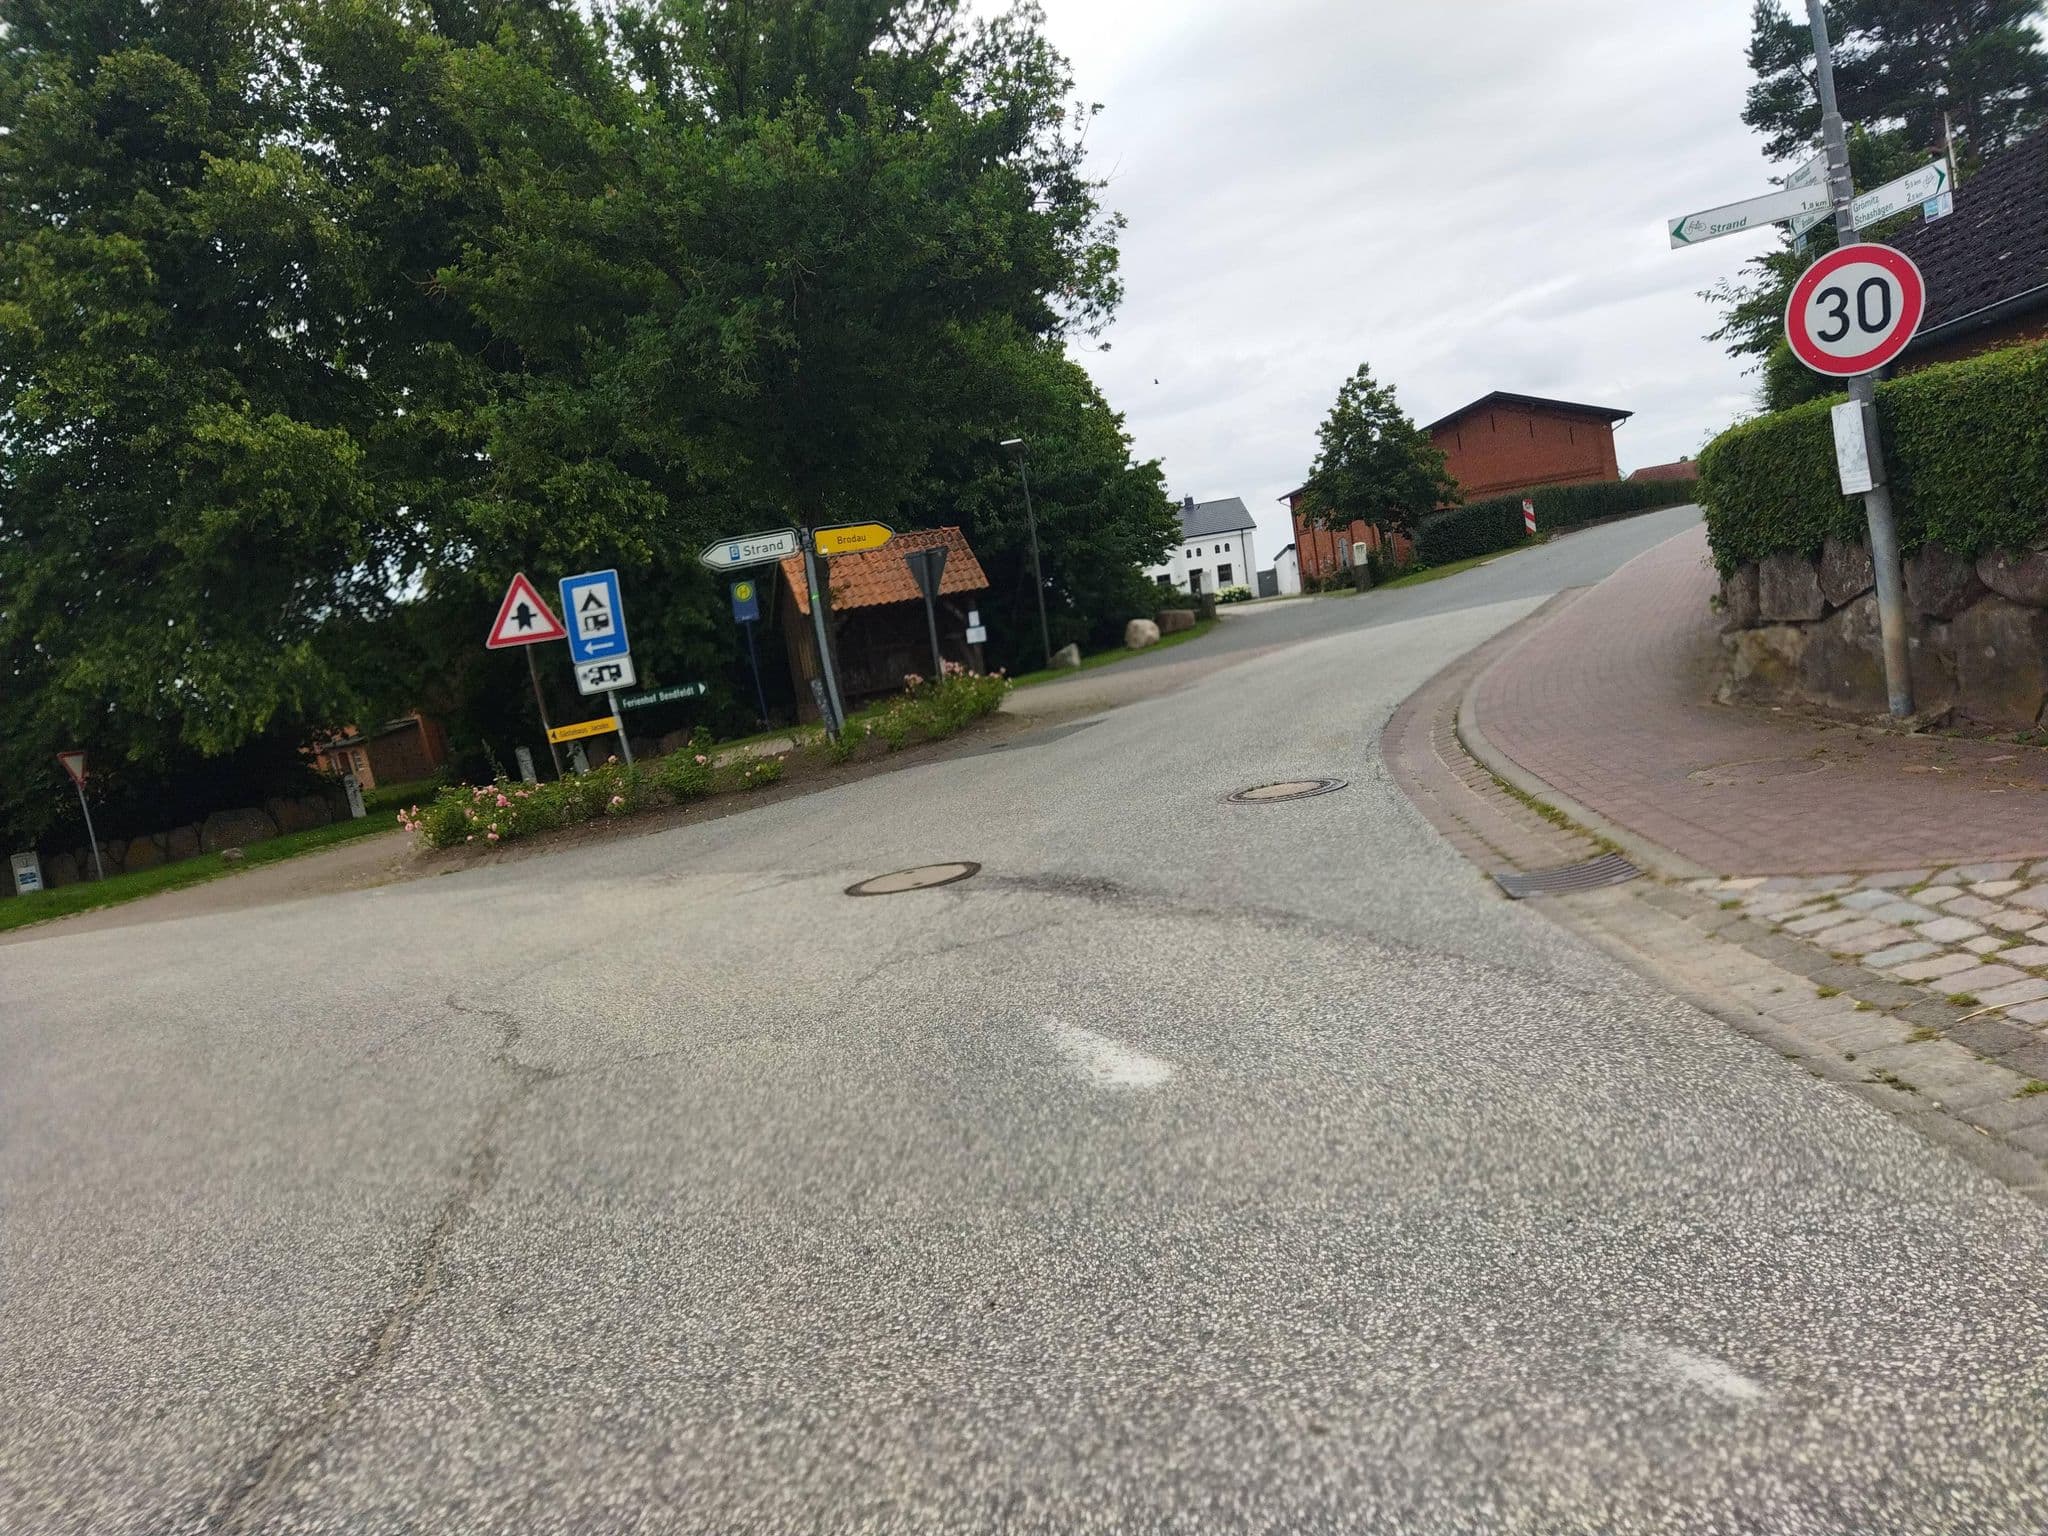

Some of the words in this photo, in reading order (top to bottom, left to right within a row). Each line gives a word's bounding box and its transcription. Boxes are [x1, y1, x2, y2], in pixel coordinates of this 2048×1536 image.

[1710, 216, 1747, 234] Strand
[1816, 277, 1891, 343] 30
[743, 539, 784, 557] Strand
[837, 534, 867, 544] Brodau
[622, 693, 657, 708] Ferienhof
